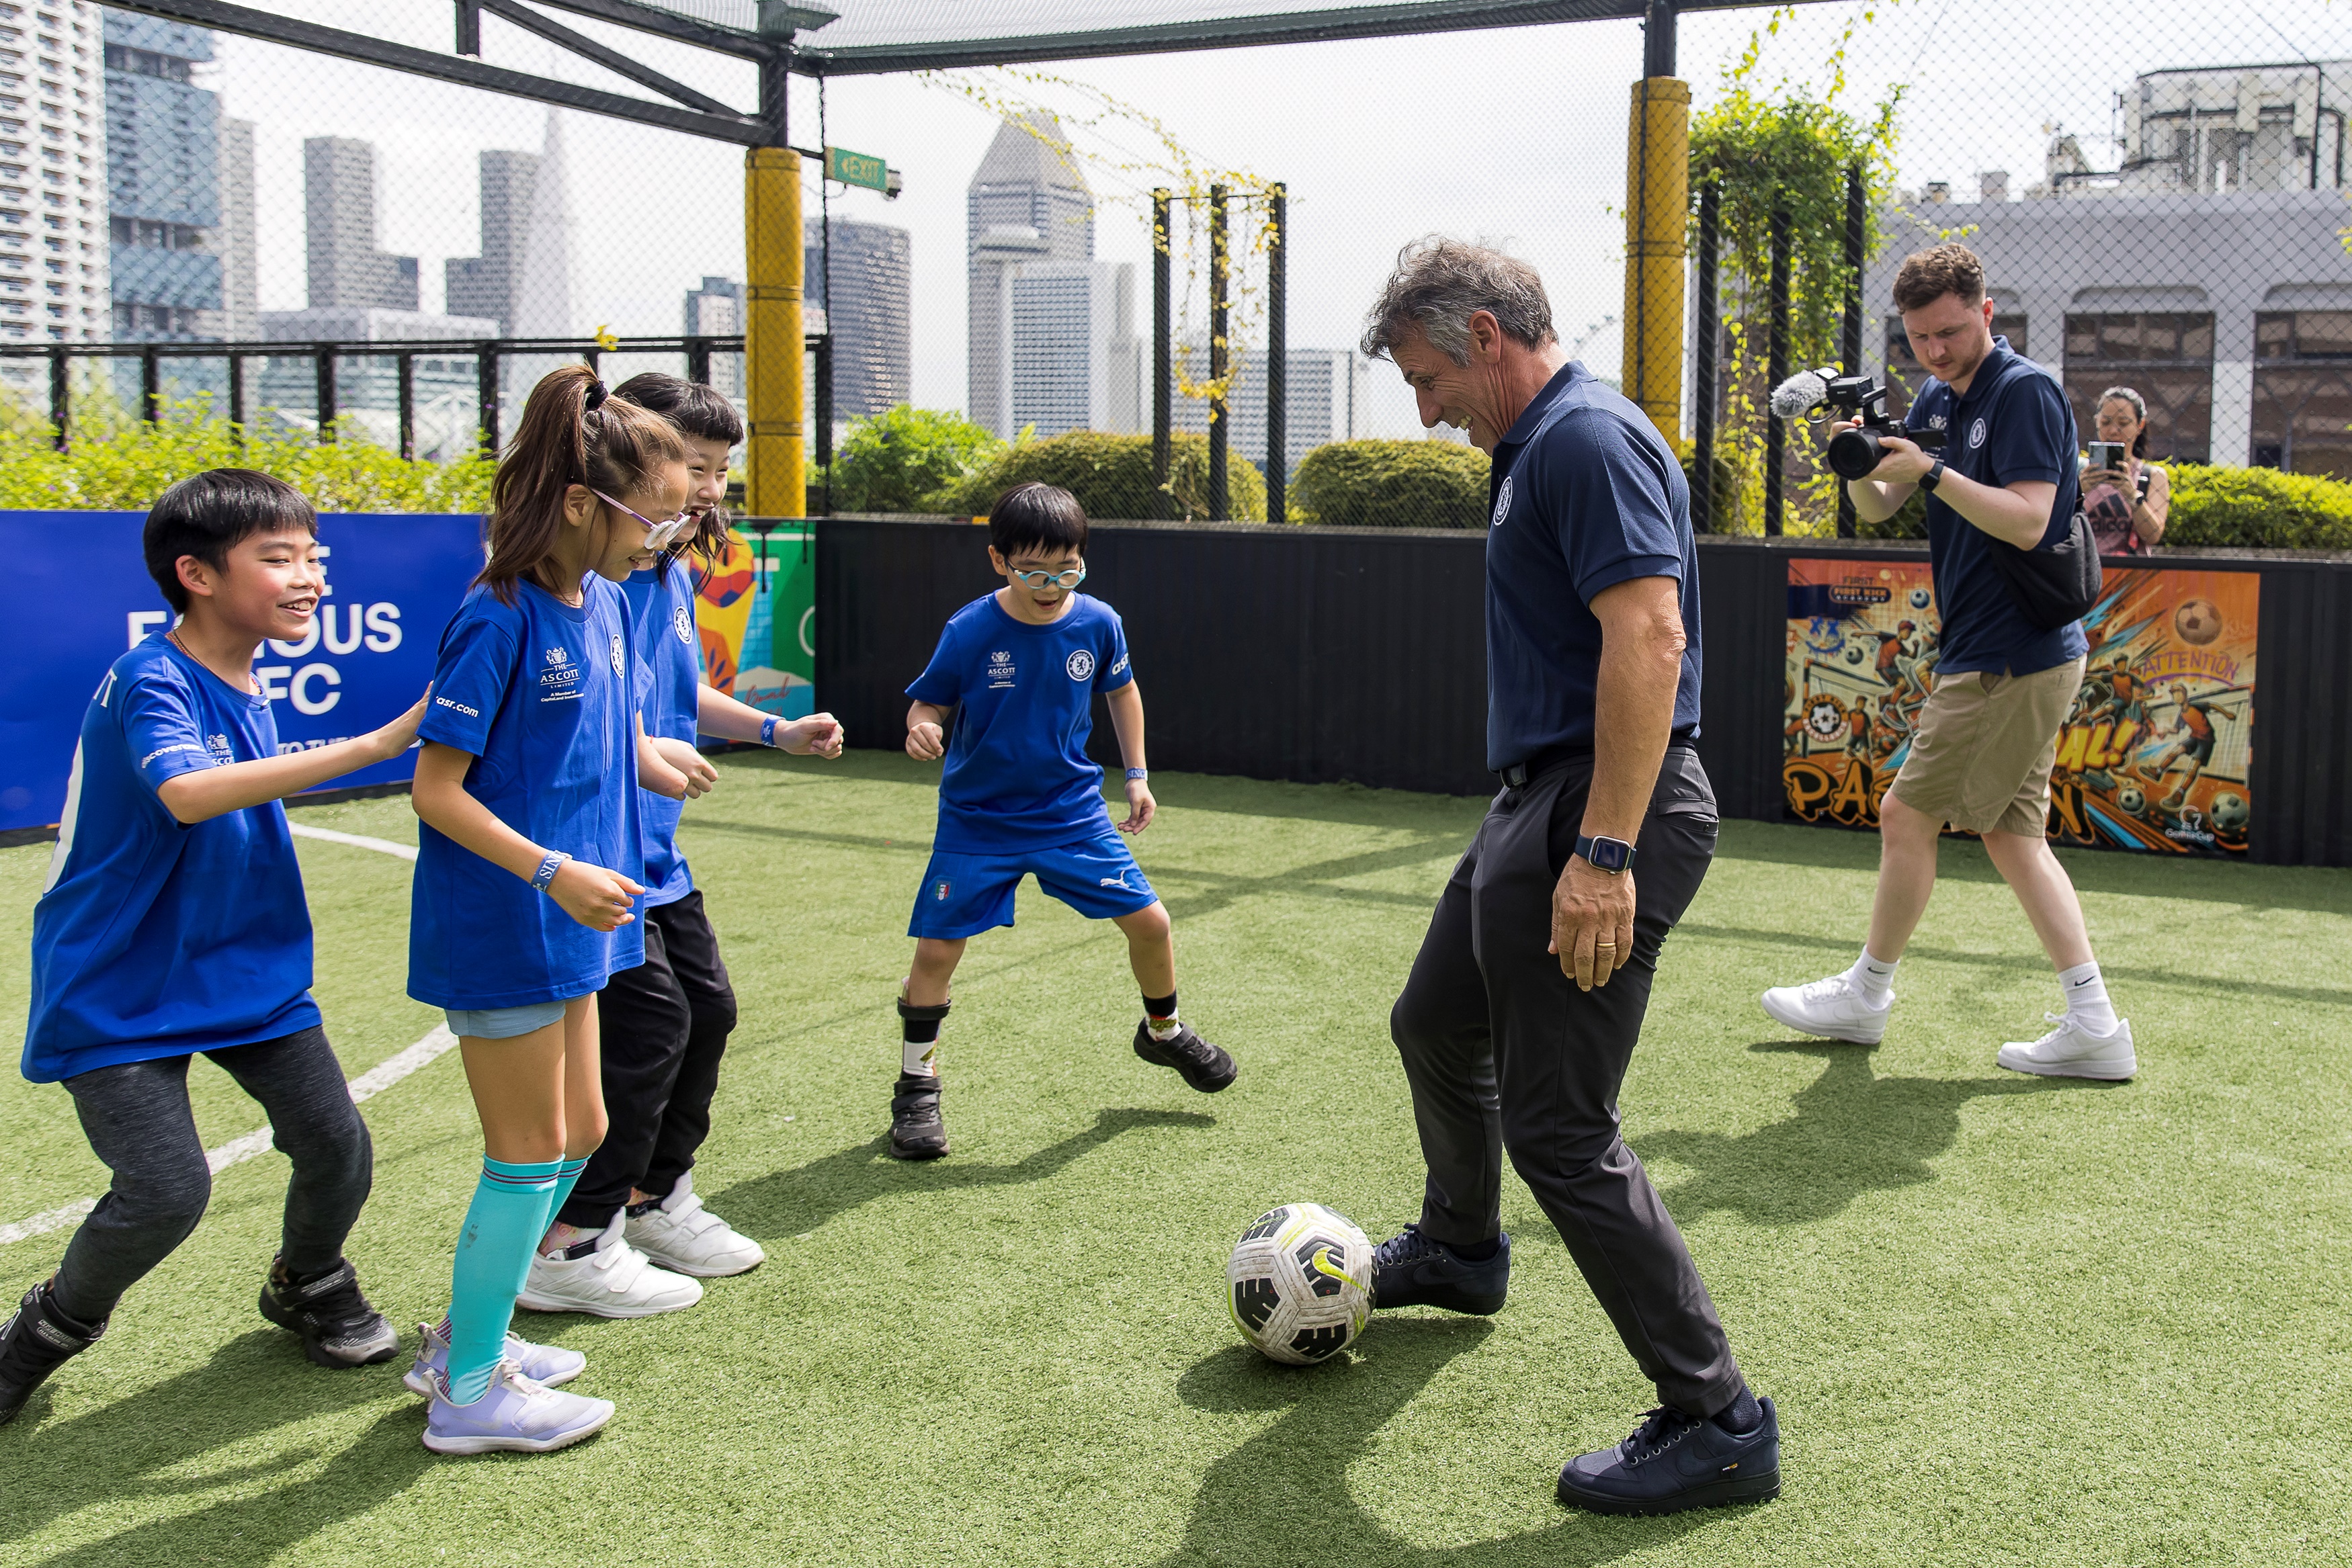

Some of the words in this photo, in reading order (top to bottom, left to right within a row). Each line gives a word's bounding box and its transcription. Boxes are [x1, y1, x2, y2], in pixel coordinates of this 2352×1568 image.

[849, 157, 880, 183] EXIT
[128, 602, 403, 659] FOUS
[540, 669, 579, 683] ASCOTT
[554, 663, 567, 671] THE
[2143, 650, 2240, 681] ATTENTION
[435, 696, 479, 718] asr.com
[215, 748, 230, 756] THE
[2054, 717, 2141, 773] AL!
